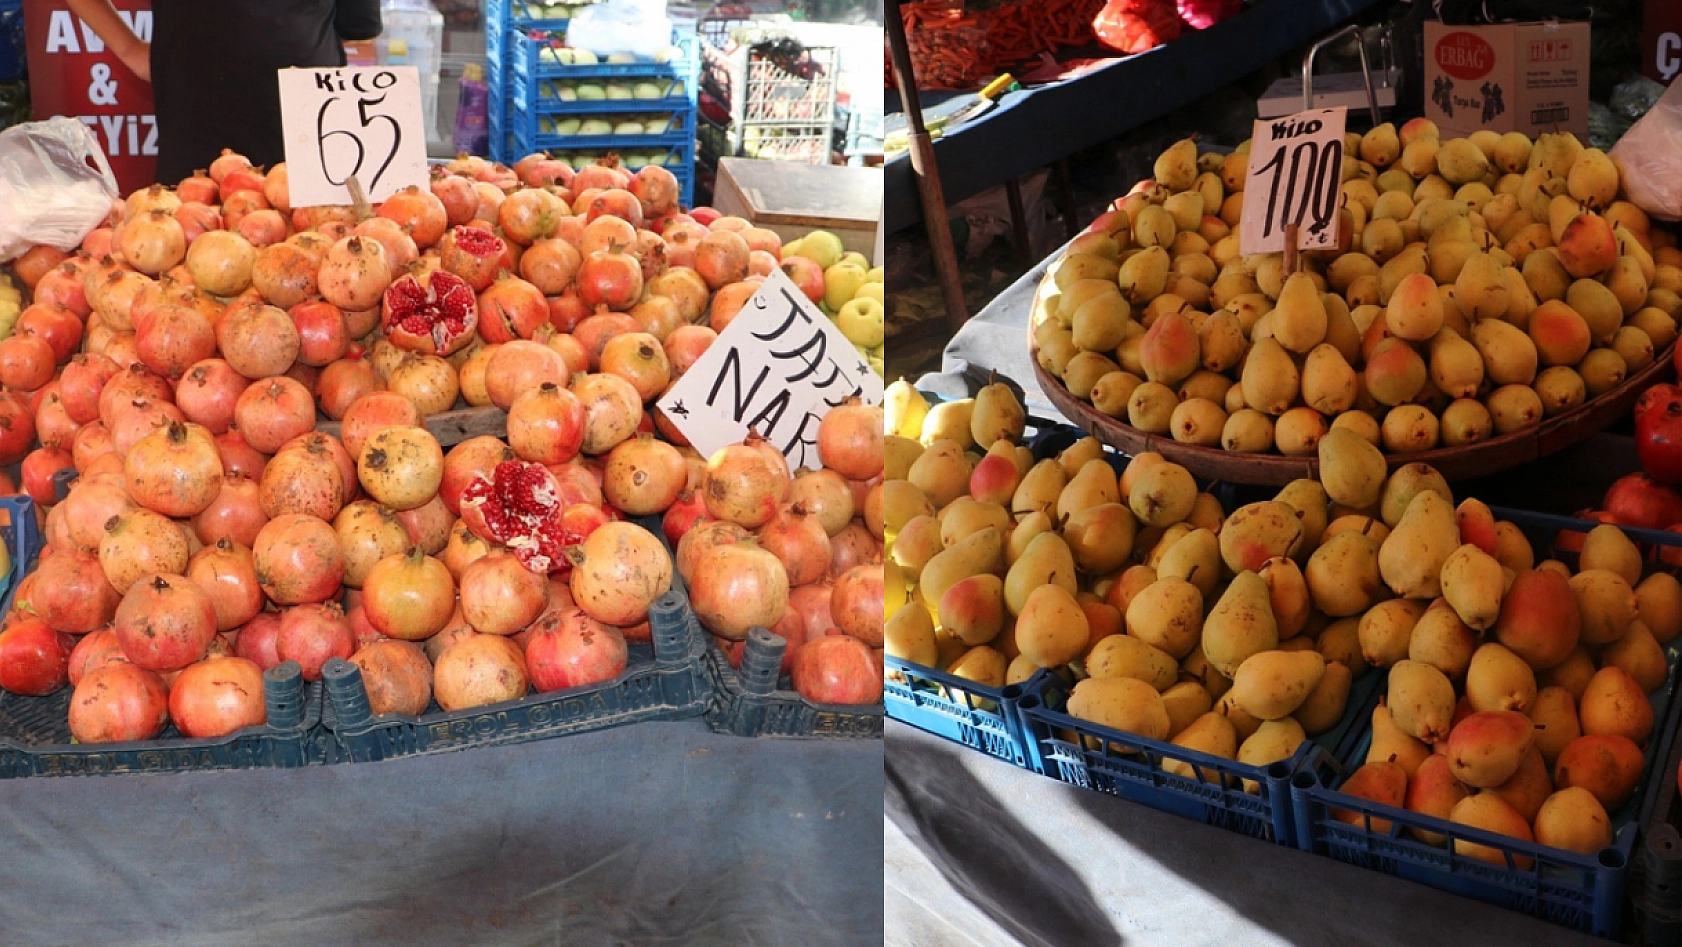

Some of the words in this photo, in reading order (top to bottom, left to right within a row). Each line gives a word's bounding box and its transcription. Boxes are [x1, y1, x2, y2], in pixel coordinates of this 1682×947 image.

[88, 63, 119, 105] &
[317, 92, 402, 195] 65
[1253, 139, 1342, 238] 100
[428, 711, 521, 742] EROL
